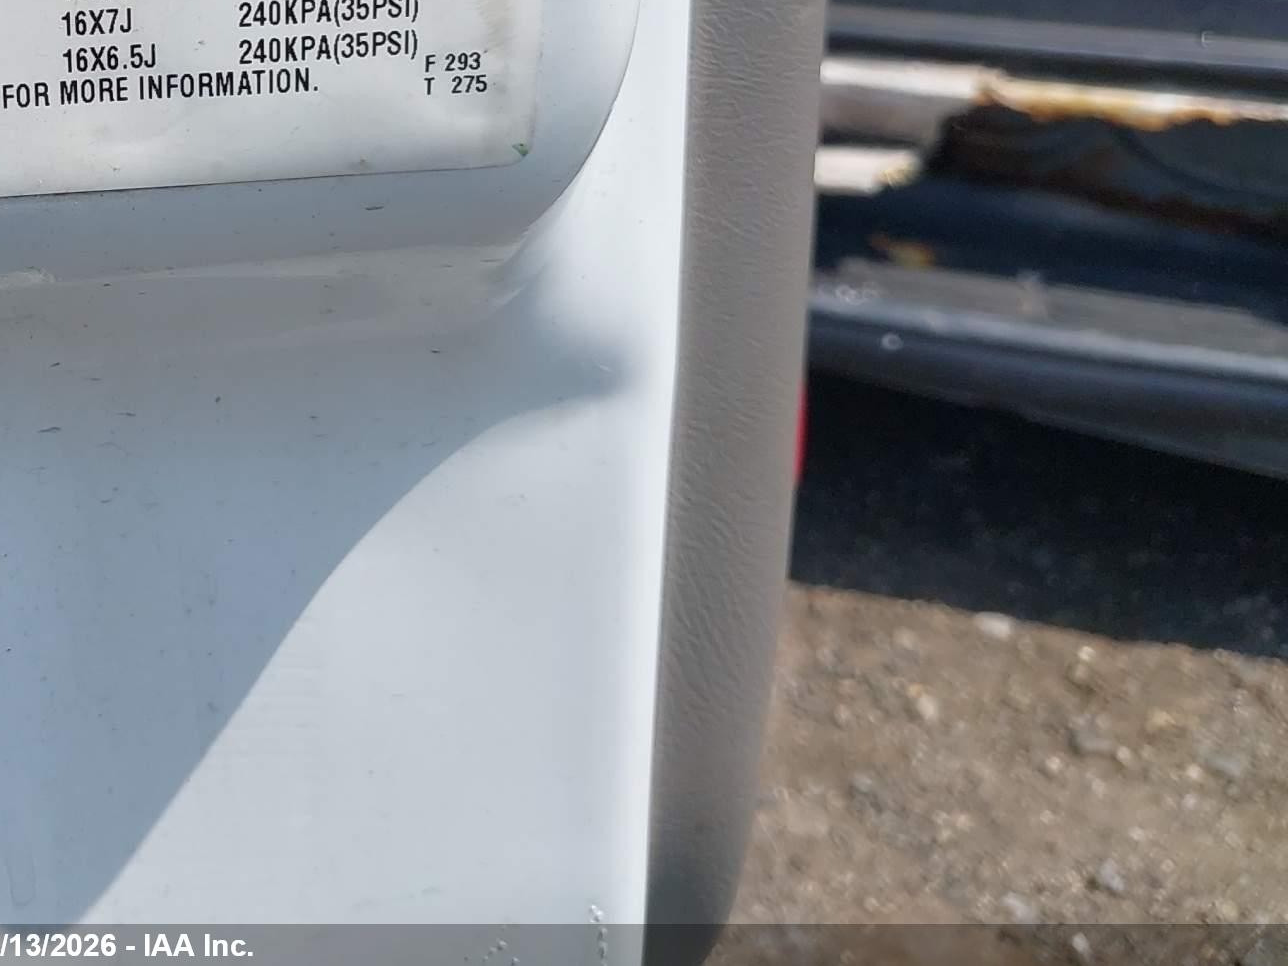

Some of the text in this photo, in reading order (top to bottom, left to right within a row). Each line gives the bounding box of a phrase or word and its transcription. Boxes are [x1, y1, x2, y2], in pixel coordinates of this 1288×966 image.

[61, 8, 131, 36] 16X7J
[63, 43, 156, 73] 16X6.5J
[239, 30, 418, 65] 240KPA(35PSI)
[425, 52, 481, 72] F 293
[3, 82, 50, 109] FOR
[60, 77, 128, 105] MORE
[140, 67, 318, 100] INFORMATION.
[424, 74, 487, 95] T 275
